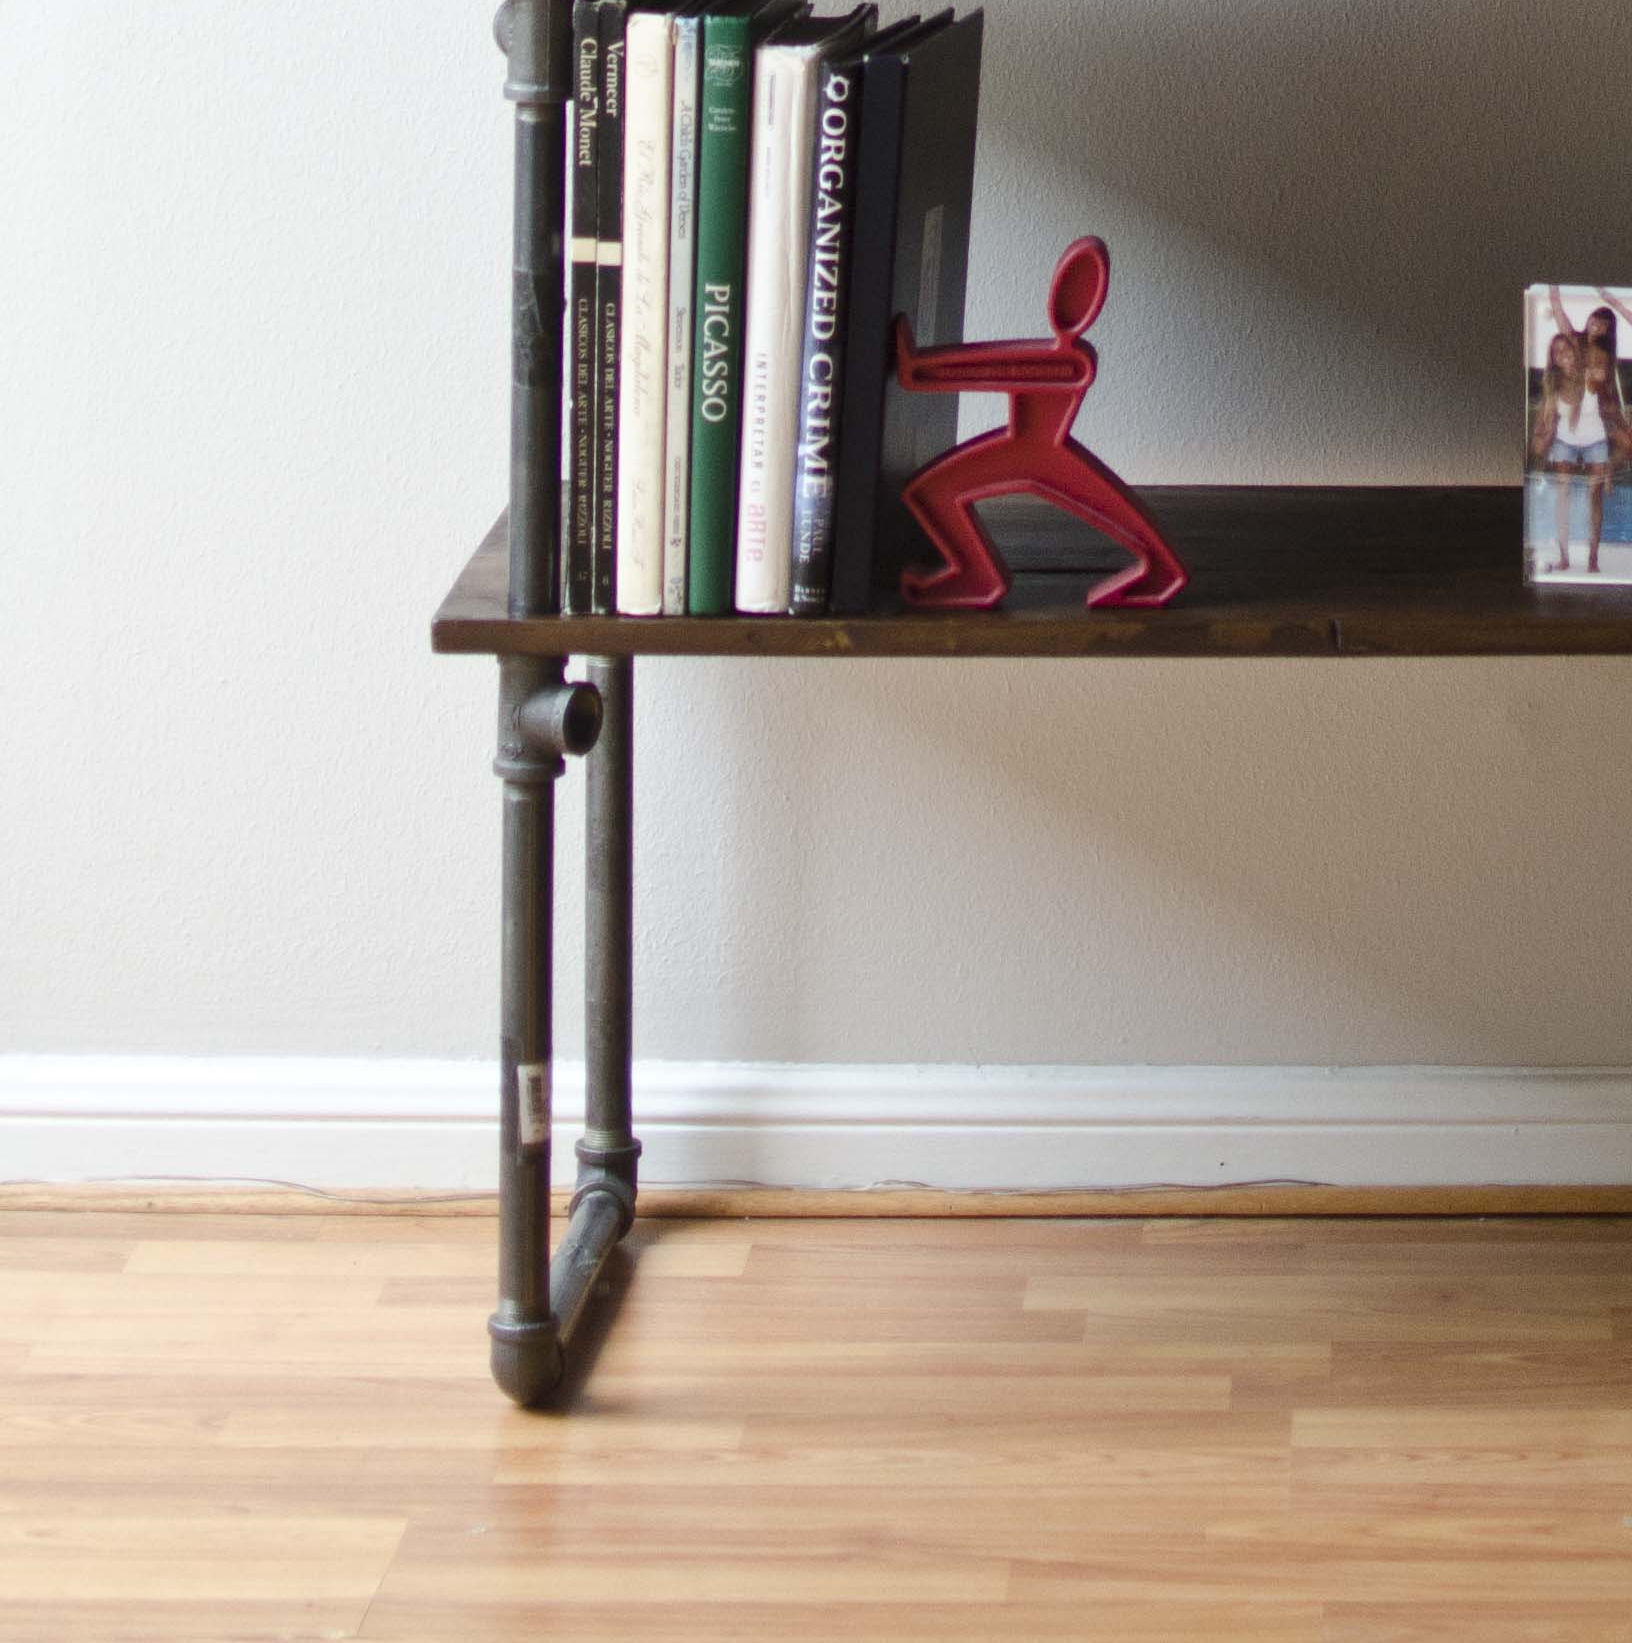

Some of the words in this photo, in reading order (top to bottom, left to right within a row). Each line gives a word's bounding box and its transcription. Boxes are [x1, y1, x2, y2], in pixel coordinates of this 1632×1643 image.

[579, 38, 598, 101] Claude
[606, 41, 624, 117] Vermeer
[579, 97, 598, 167] Monet
[812, 108, 848, 341] ORGANIZED
[578, 298, 589, 360] CLASICOS
[605, 302, 616, 364] CLASICOS
[701, 283, 731, 422] PICASSO
[577, 363, 588, 386] DEL
[604, 368, 615, 390] DEL
[577, 394, 588, 426] ARTE
[604, 399, 614, 430] ARTE
[753, 352, 768, 471] INTERPRETAR
[802, 352, 834, 498] CRIME
[577, 434, 588, 489] NOGUER
[603, 439, 613, 493] NOGUER
[577, 495, 587, 544] RIZZOLI
[602, 500, 613, 549] RIZZOLI
